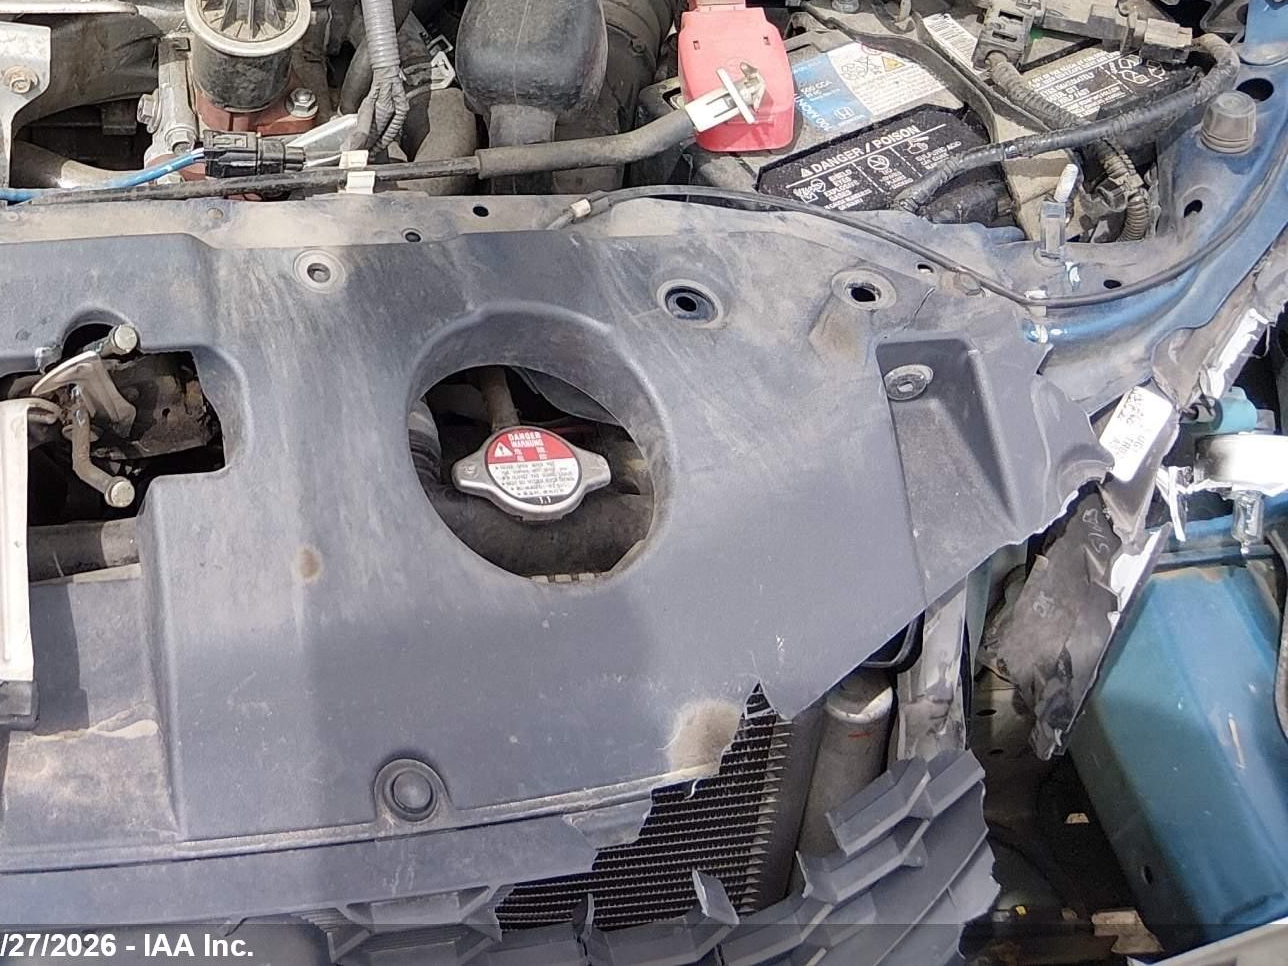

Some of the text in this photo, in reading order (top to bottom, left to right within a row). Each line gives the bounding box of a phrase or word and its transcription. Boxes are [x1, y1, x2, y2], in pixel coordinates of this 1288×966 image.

[813, 147, 863, 172] DANGER
[873, 125, 923, 149] POISON
[507, 431, 542, 442] DANGER
